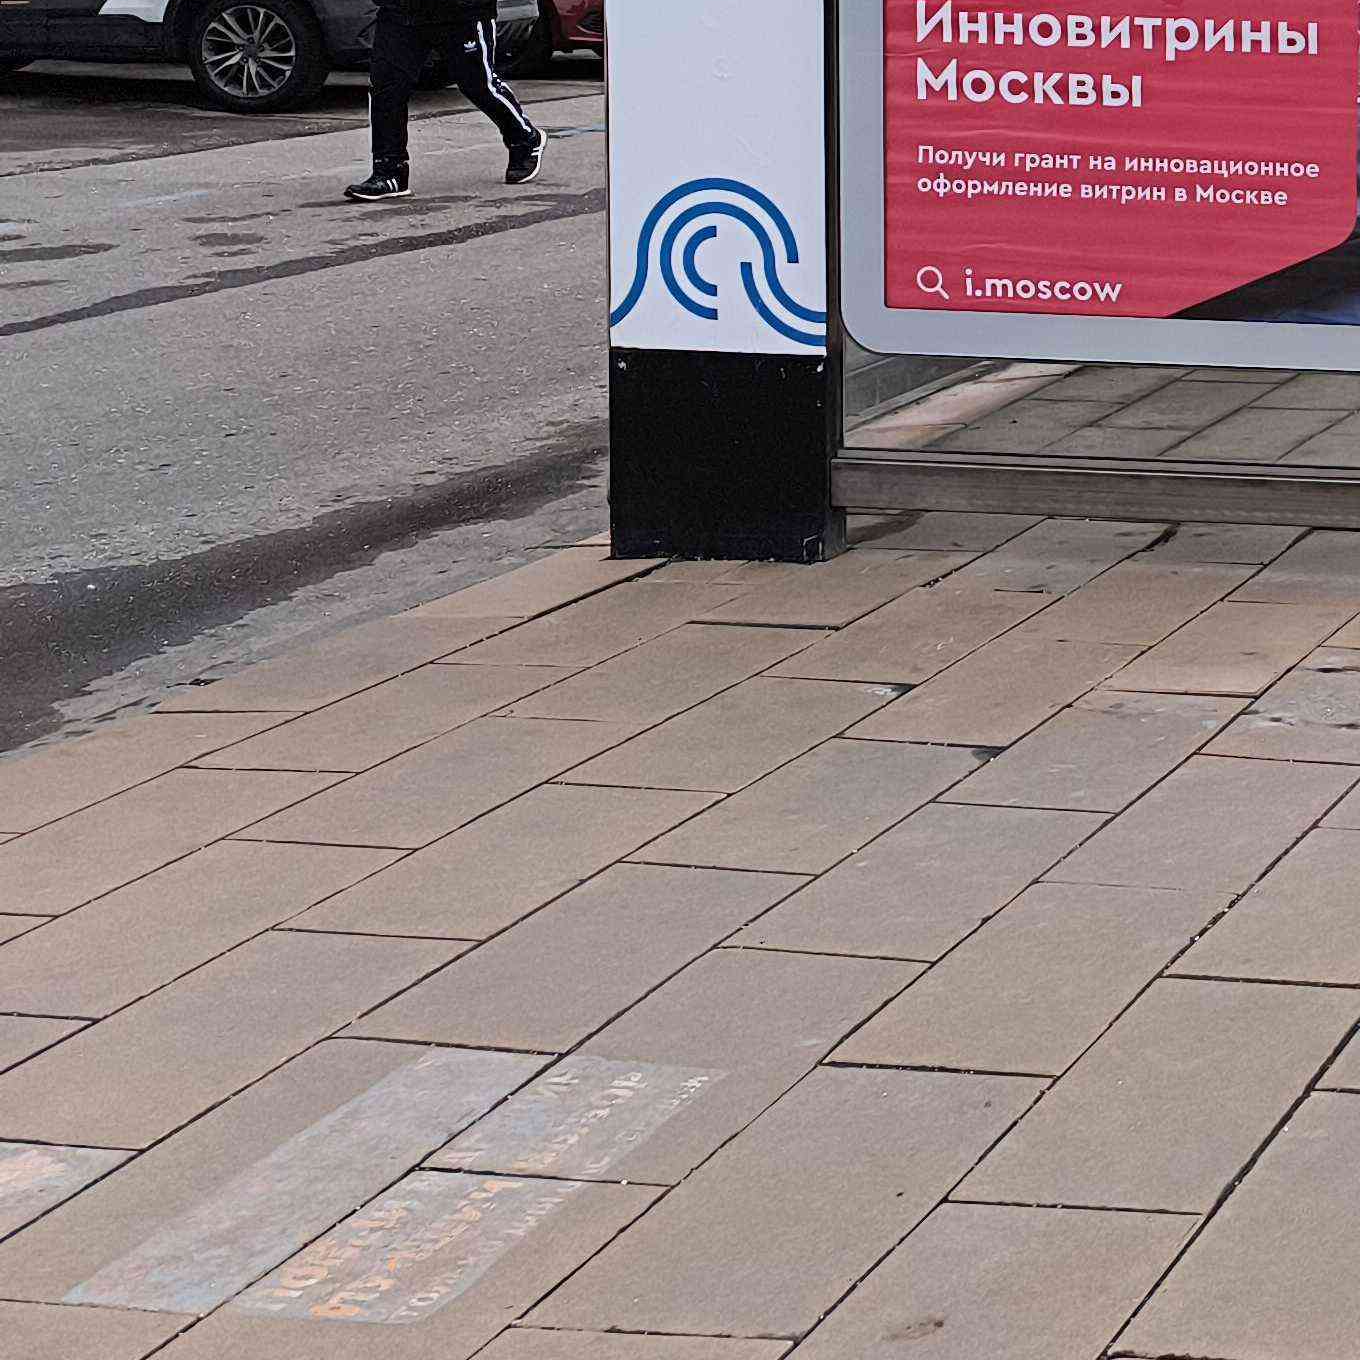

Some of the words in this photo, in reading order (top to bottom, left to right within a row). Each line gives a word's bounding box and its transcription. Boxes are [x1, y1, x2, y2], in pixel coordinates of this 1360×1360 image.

[916, 0, 1318, 61] Инновитрины
[916, 57, 1142, 107] Москвы
[918, 145, 1005, 174] Получи
[1014, 151, 1081, 174] грант
[1089, 153, 1116, 171] на
[1124, 154, 1319, 180] инновационное
[917, 172, 1072, 201] оформление
[1081, 178, 1166, 205] витрин
[1175, 186, 1187, 202] в
[1196, 184, 1287, 205] Москве
[965, 268, 1122, 303] i.moscow
